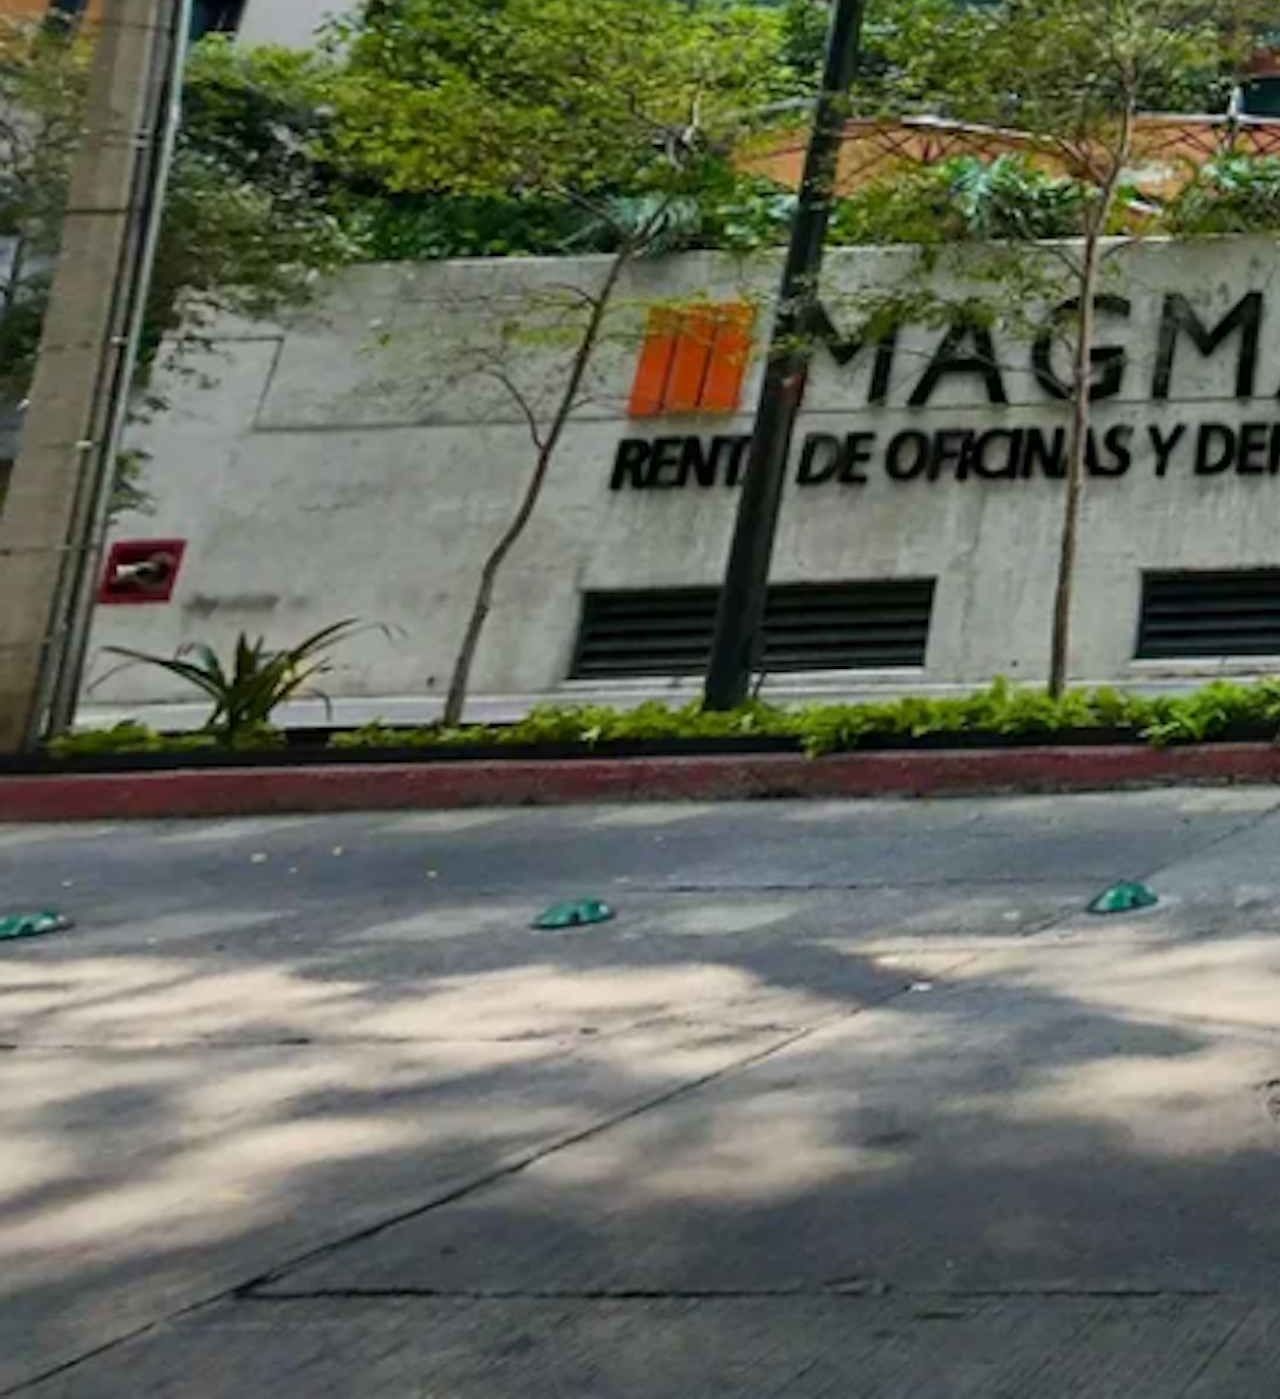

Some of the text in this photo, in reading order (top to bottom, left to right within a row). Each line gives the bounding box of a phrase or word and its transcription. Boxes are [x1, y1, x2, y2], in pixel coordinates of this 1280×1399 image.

[608, 435, 775, 489] RENT
[796, 431, 874, 484] DE
[1147, 422, 1187, 477] Y
